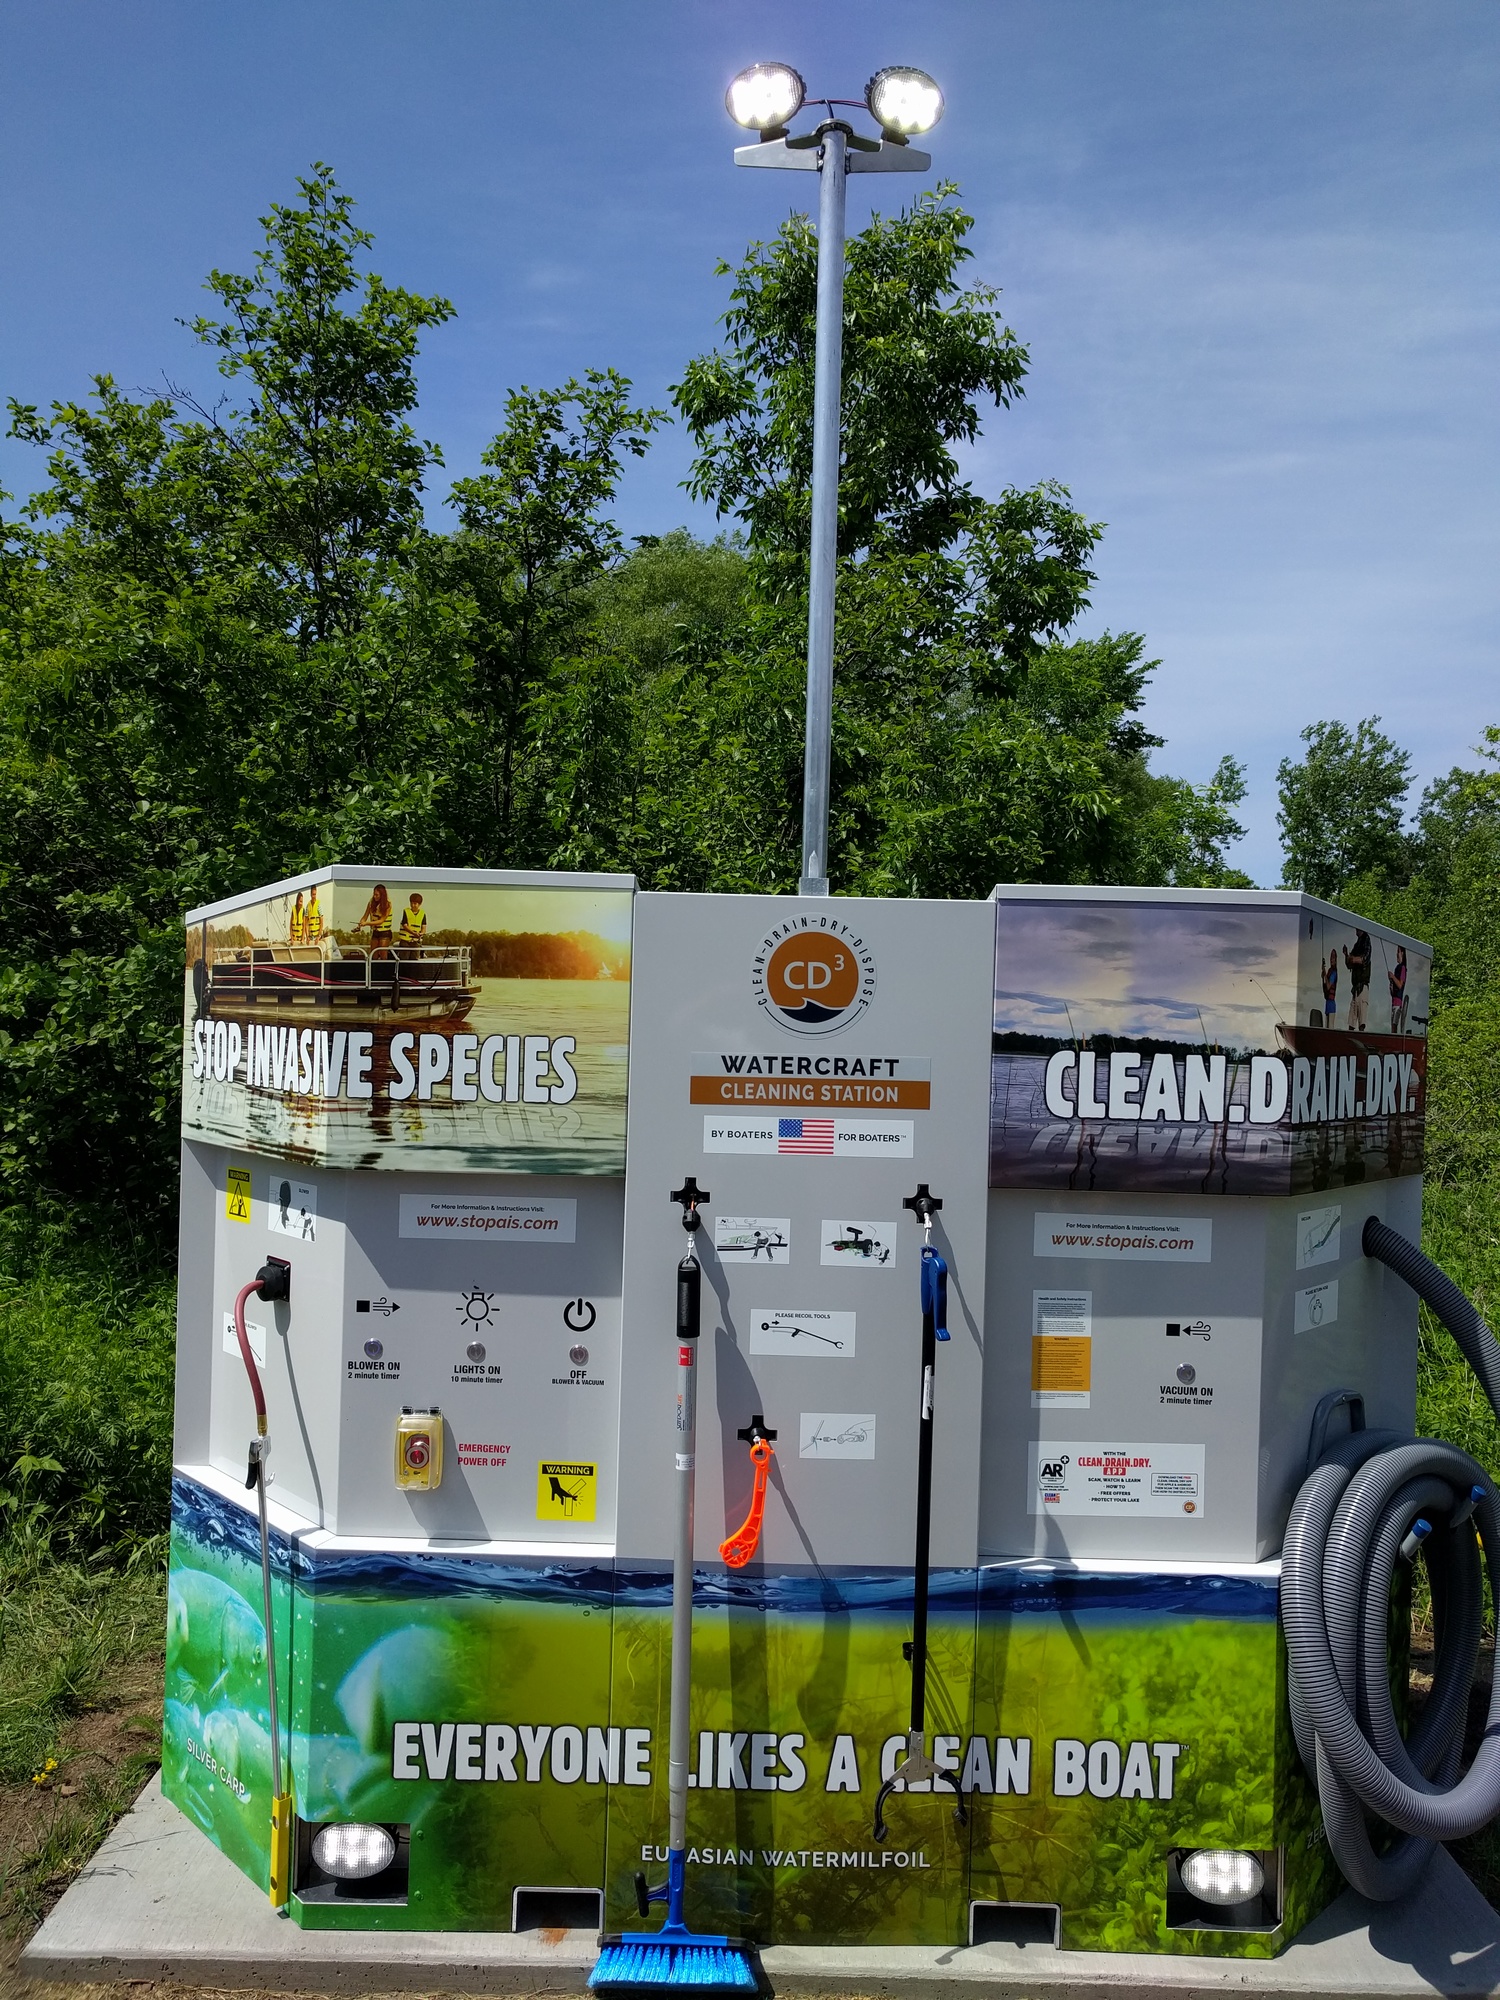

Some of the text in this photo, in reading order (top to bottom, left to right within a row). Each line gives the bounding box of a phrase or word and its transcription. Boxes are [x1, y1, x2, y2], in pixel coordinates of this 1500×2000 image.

[193, 1019, 578, 1104] STOP INVASIVE SPECIES
[721, 1055, 899, 1076] WATERCRAFT
[720, 1083, 899, 1103] CLEANING STATION
[711, 1129, 774, 1140] BY BOATERS
[838, 1133, 856, 1142] FOR
[229, 1170, 249, 1182] WARNING
[416, 1215, 559, 1231] www.stopais.com
[1051, 1234, 1194, 1251] www.stopais.com
[348, 1361, 400, 1371] BLOWER ON
[454, 1365, 501, 1375] LIGHTS ON
[570, 1370, 587, 1379] OFF
[1160, 1386, 1213, 1396] VACUUM ON
[459, 1444, 511, 1454] EMERGENCY
[458, 1457, 507, 1466] POWER OFF
[546, 1465, 590, 1475] WARNING
[393, 1723, 651, 1785] EVERYONE
[688, 1732, 806, 1792] IKES
[826, 1735, 860, 1792] A
[187, 1738, 246, 1798] SILVER CARP
[642, 1845, 930, 1868] EUASIAN WATERMILFOIL
